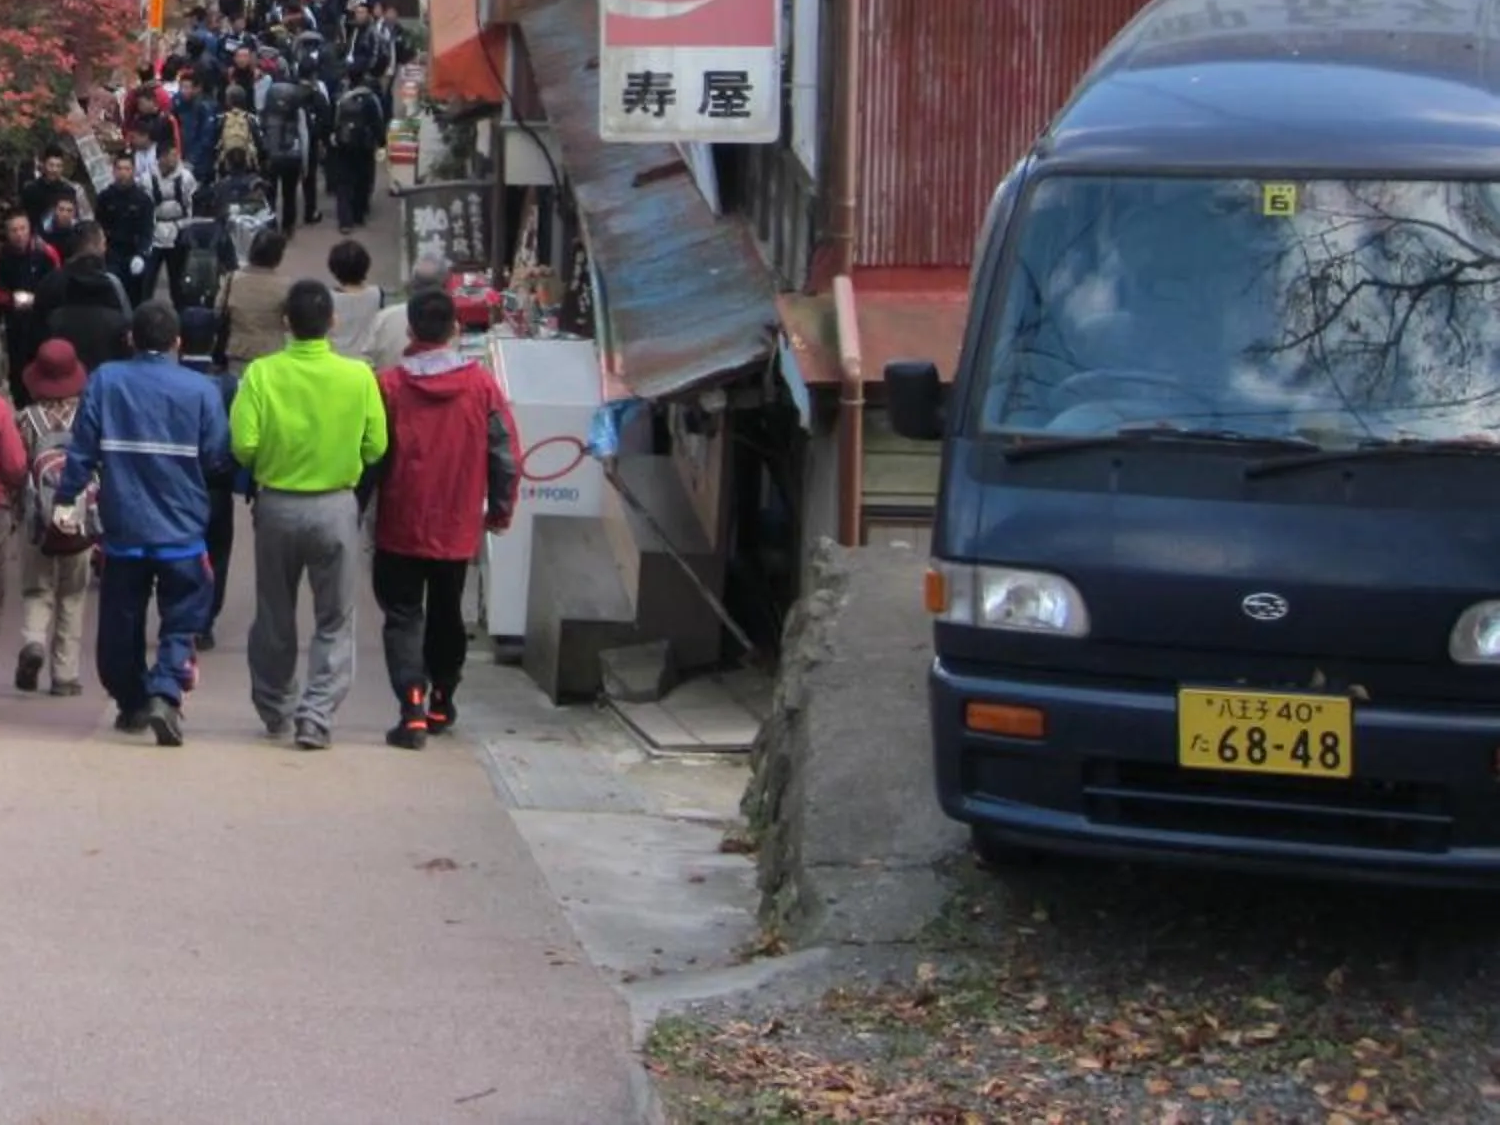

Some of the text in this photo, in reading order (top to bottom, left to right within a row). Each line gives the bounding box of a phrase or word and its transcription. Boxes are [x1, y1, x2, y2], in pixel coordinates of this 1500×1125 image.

[622, 69, 754, 119] 寿屋
[1218, 698, 1313, 724] 八王子 40
[1189, 725, 1341, 770] た 68-48
